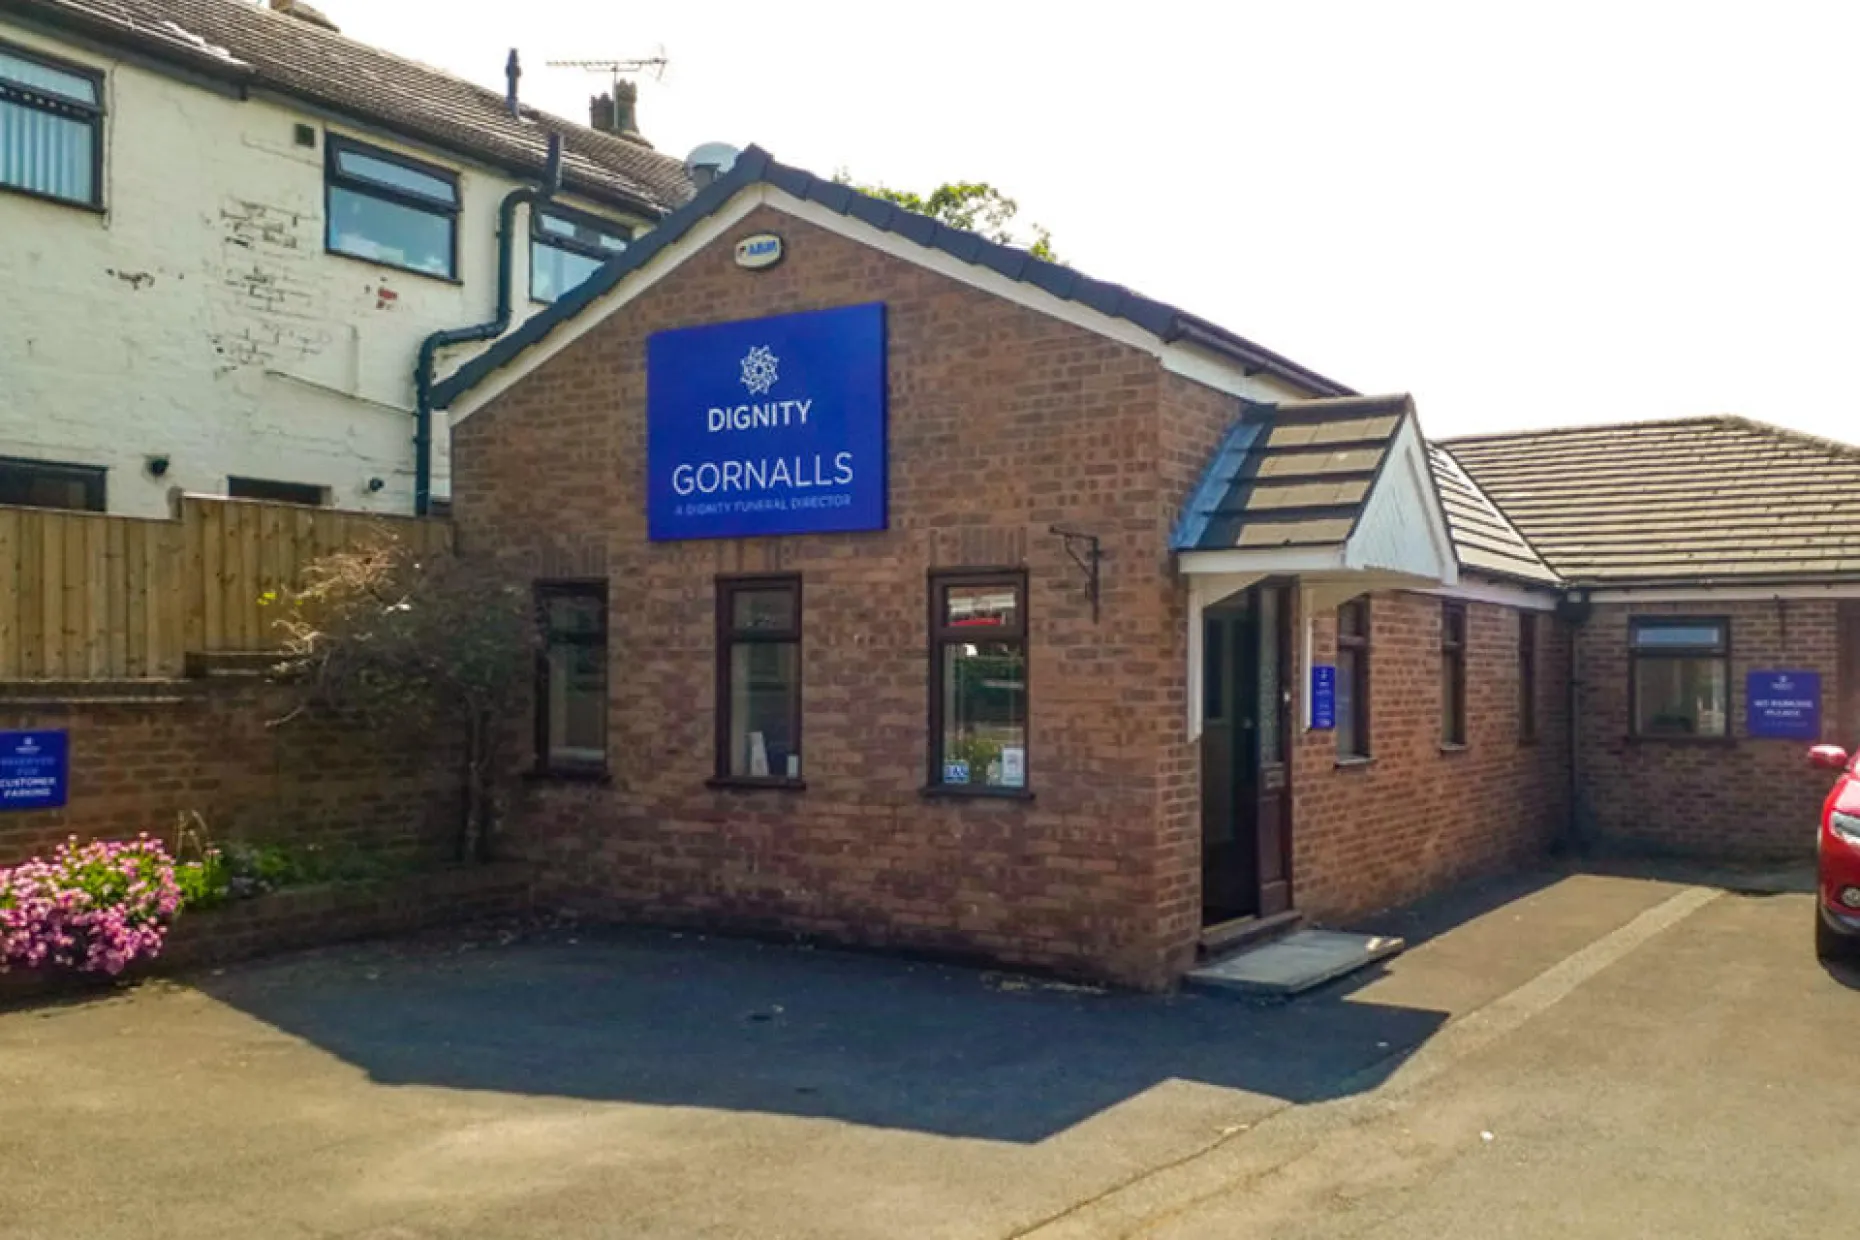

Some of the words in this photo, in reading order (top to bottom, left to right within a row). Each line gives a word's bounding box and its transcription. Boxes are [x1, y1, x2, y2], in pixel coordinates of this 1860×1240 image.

[708, 399, 812, 432] DIGNITY
[673, 452, 853, 495] GORNALLS
[674, 504, 683, 516] A
[686, 501, 732, 516] DIGNITY
[734, 498, 788, 513] FUNERAL
[791, 494, 852, 510] DIRECTOR
